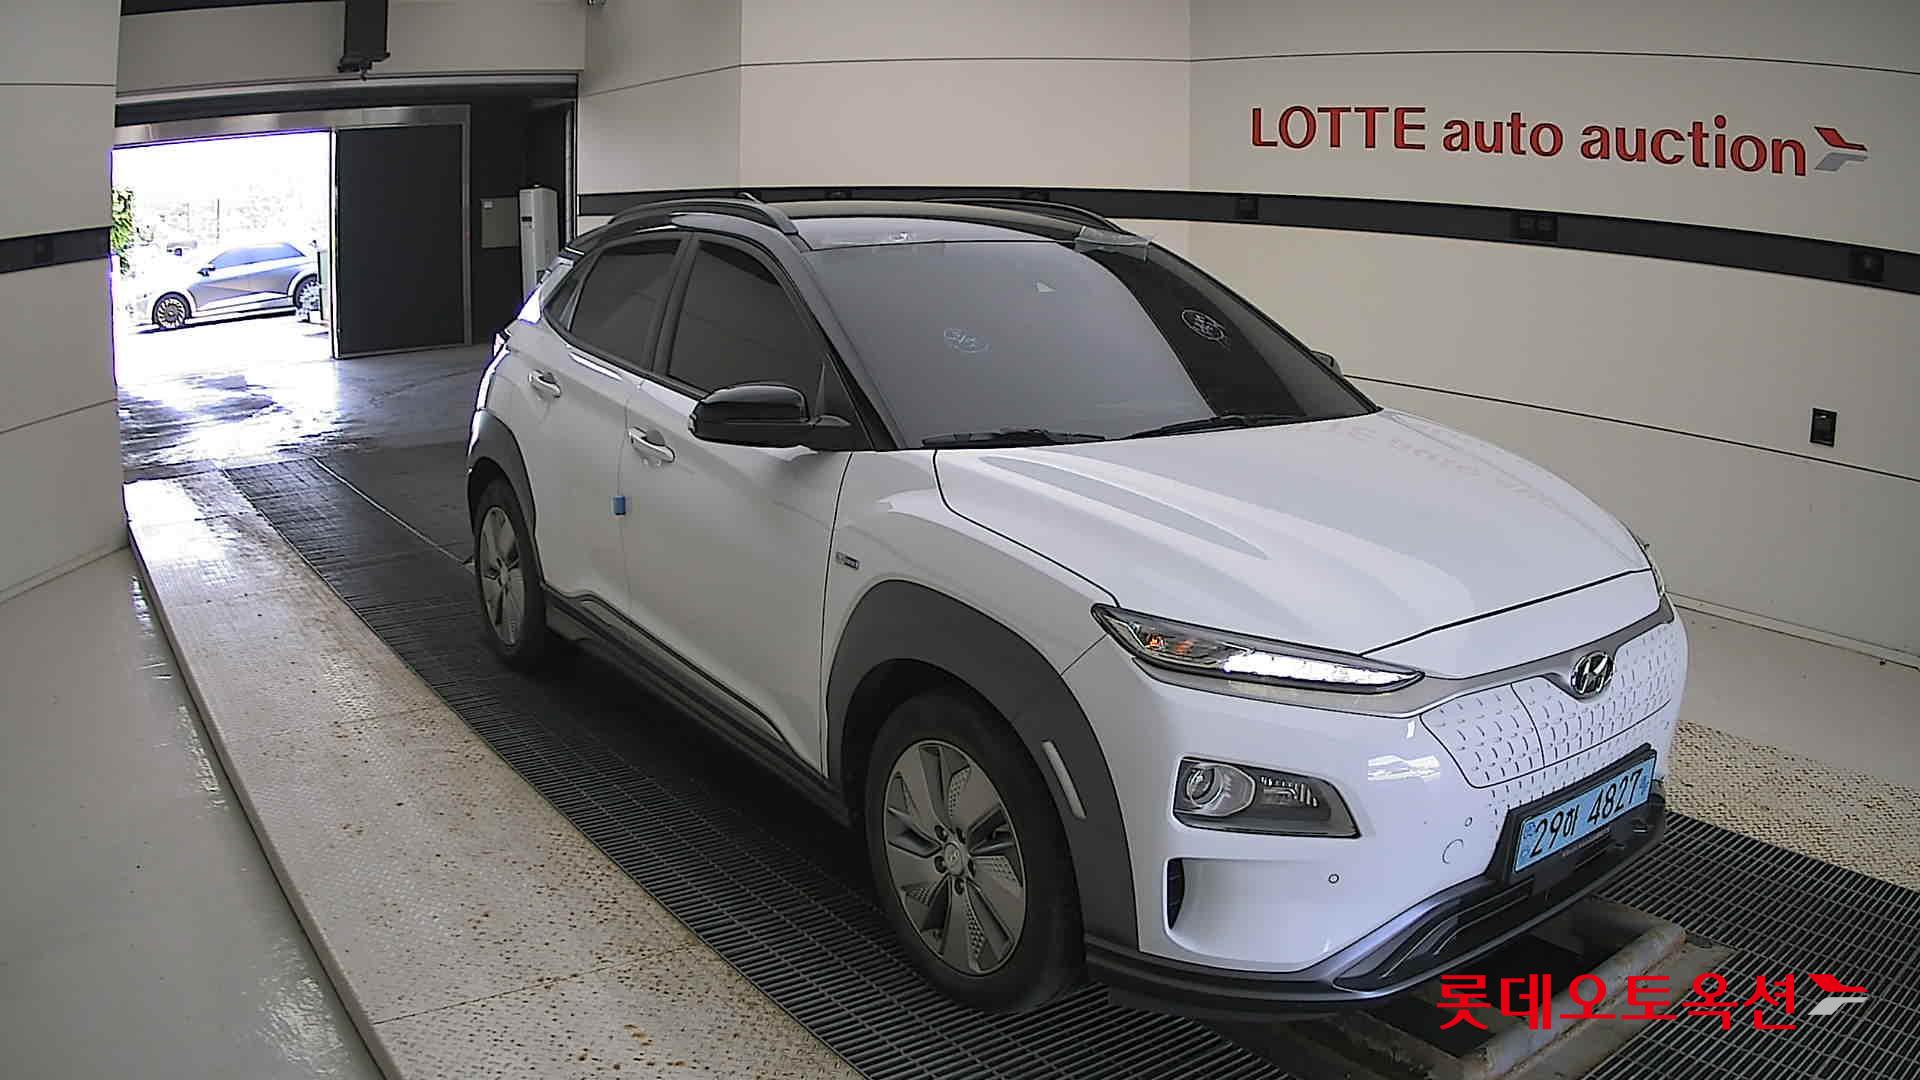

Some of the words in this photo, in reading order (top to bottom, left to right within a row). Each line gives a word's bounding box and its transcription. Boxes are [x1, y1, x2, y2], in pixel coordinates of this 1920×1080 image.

[1251, 106, 1426, 150] LOTTE
[1442, 112, 1564, 157] auto
[1580, 115, 1808, 177] auction
[1587, 768, 1644, 825] 4827
